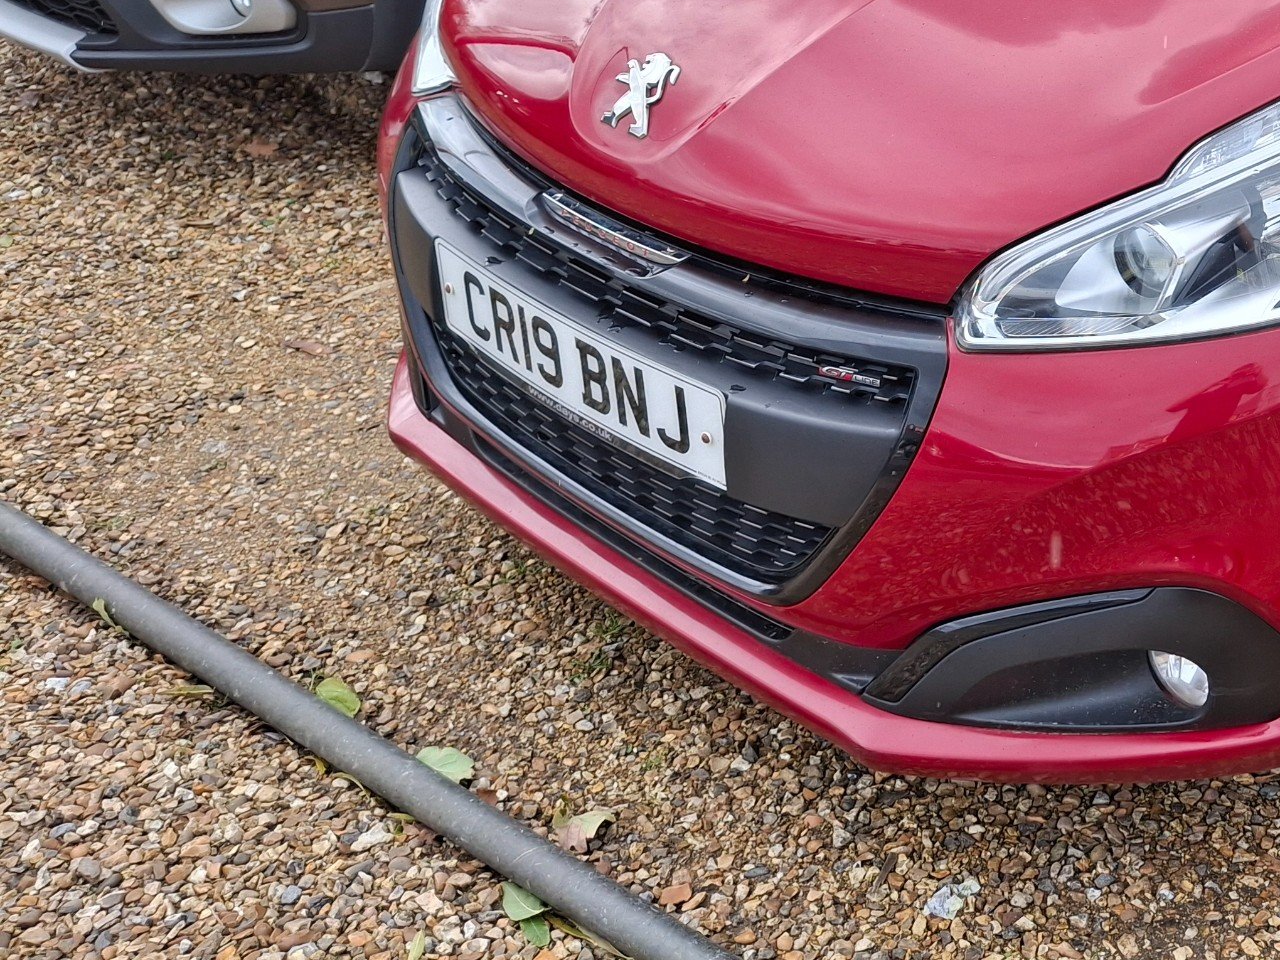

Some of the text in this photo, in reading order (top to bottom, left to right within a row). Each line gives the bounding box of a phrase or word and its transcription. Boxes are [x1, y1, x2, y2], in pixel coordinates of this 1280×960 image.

[560, 208, 651, 258] PEUGEOT
[463, 270, 692, 455] CR19 BNJ
[528, 385, 613, 441] www.days.co.uk
